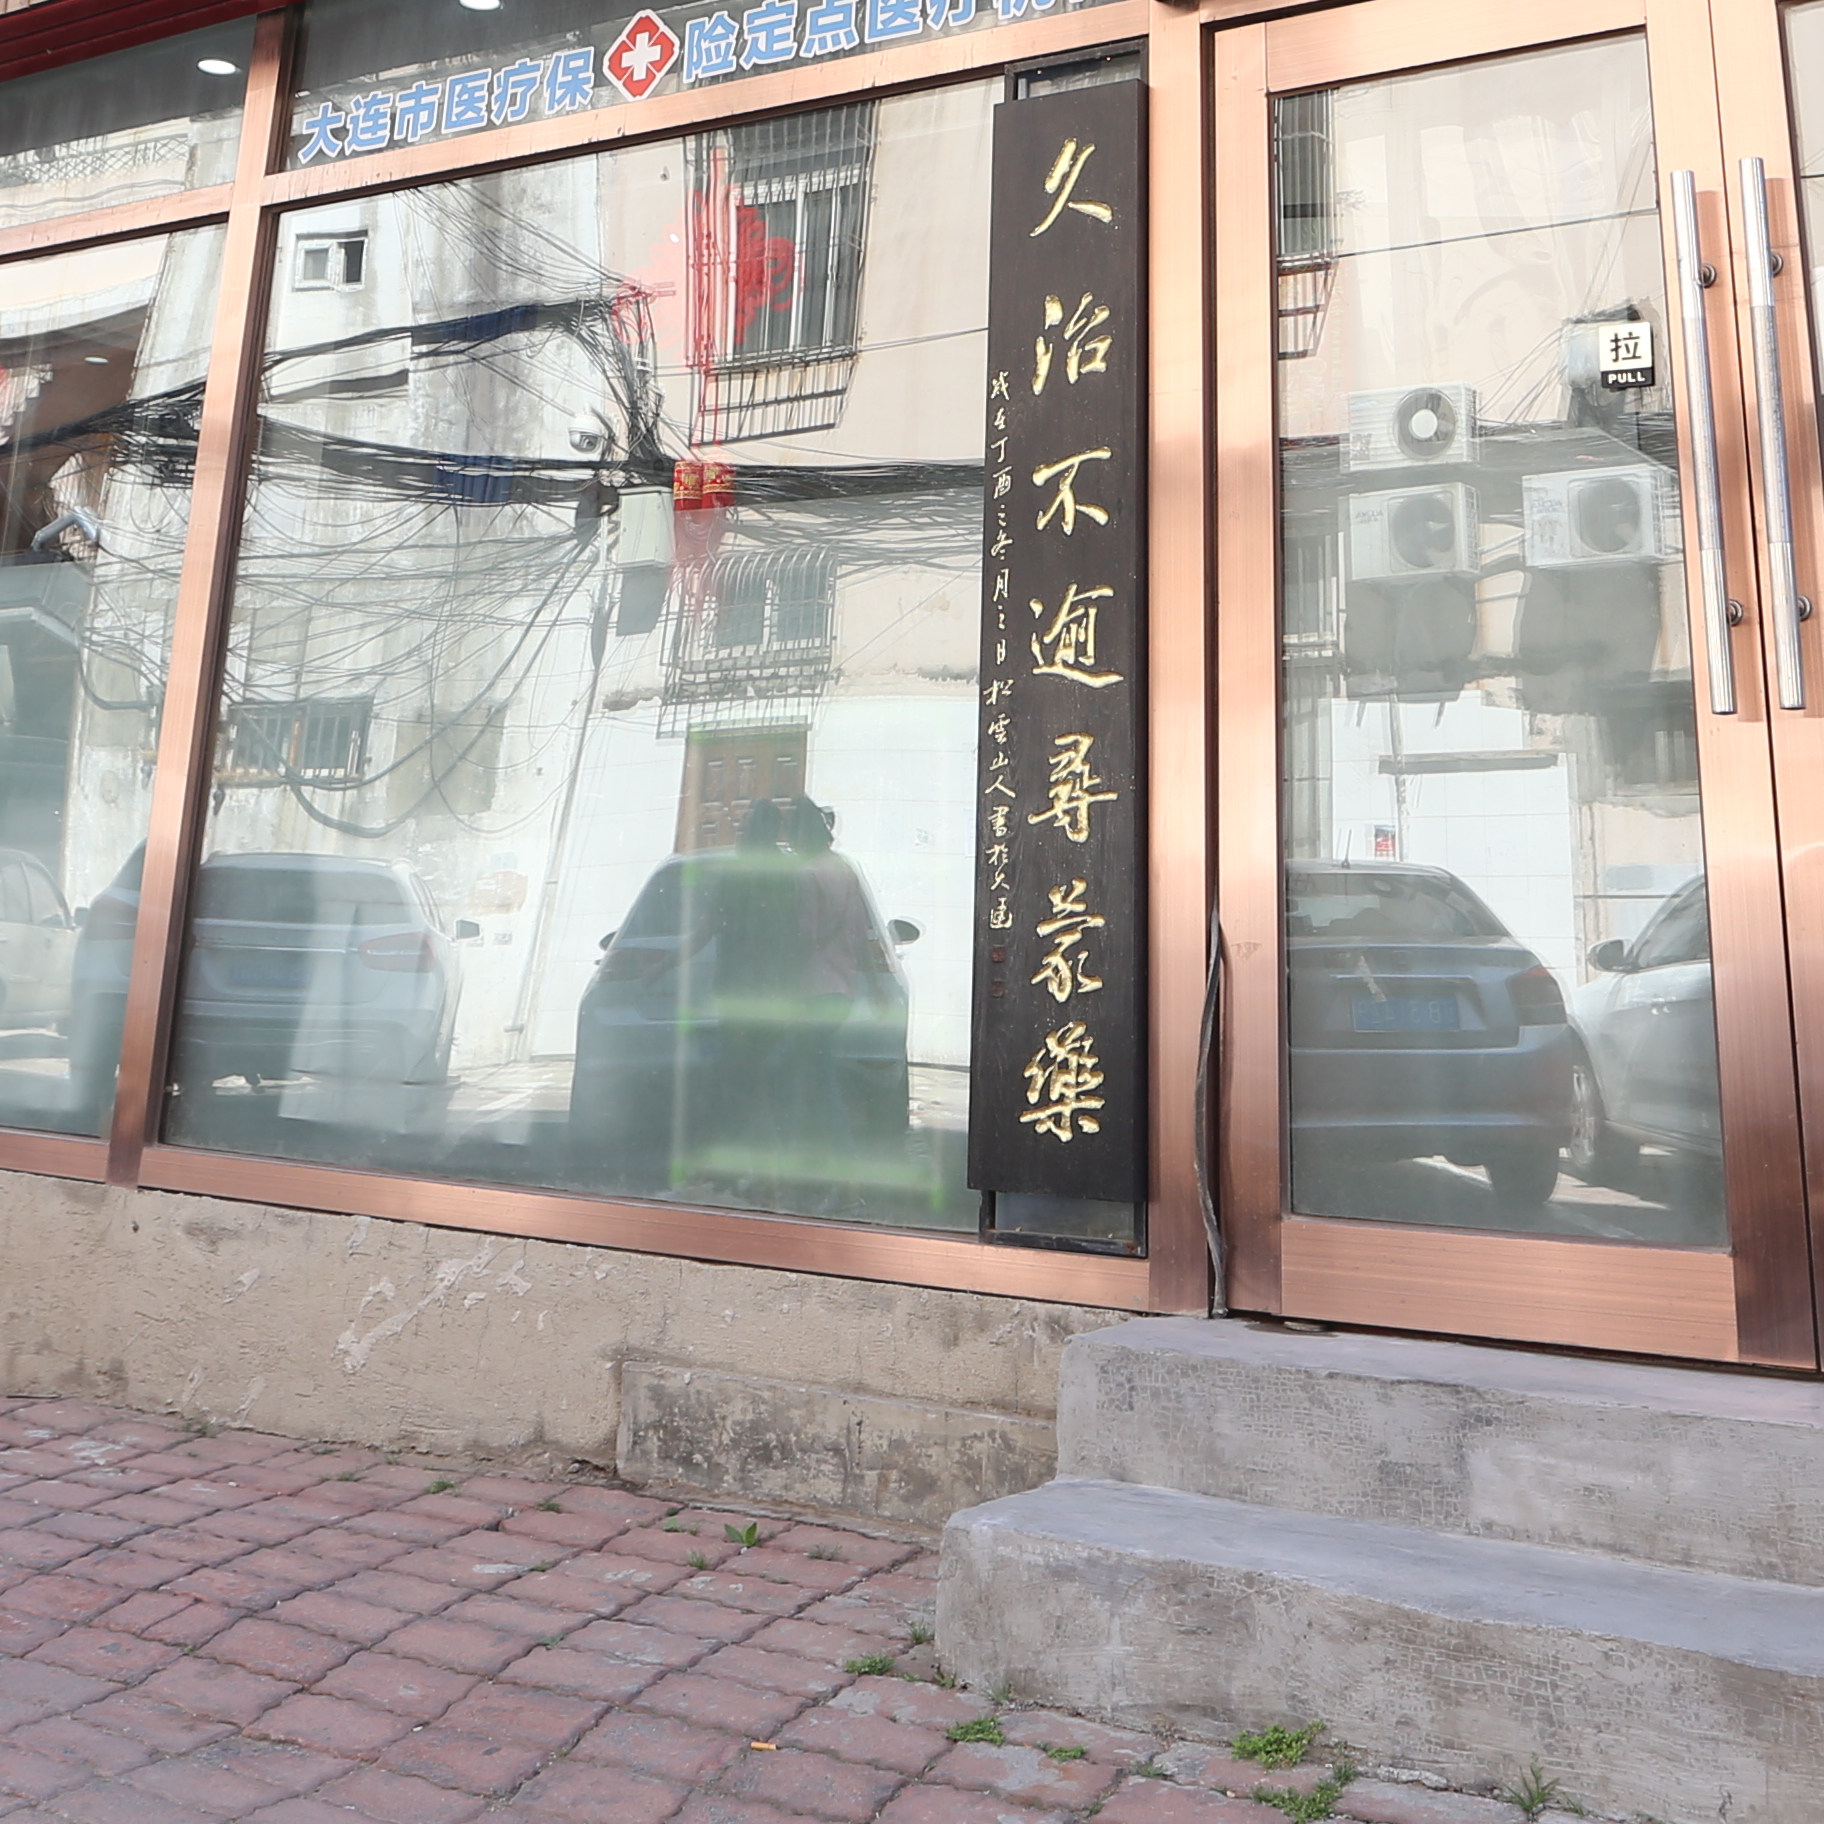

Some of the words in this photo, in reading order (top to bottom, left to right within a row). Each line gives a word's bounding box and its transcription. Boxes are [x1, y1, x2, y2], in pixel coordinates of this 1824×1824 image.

[298, 44, 596, 164] 大连市医疗保
[1609, 331, 1642, 363] 拉
[1608, 371, 1646, 384] PULL
